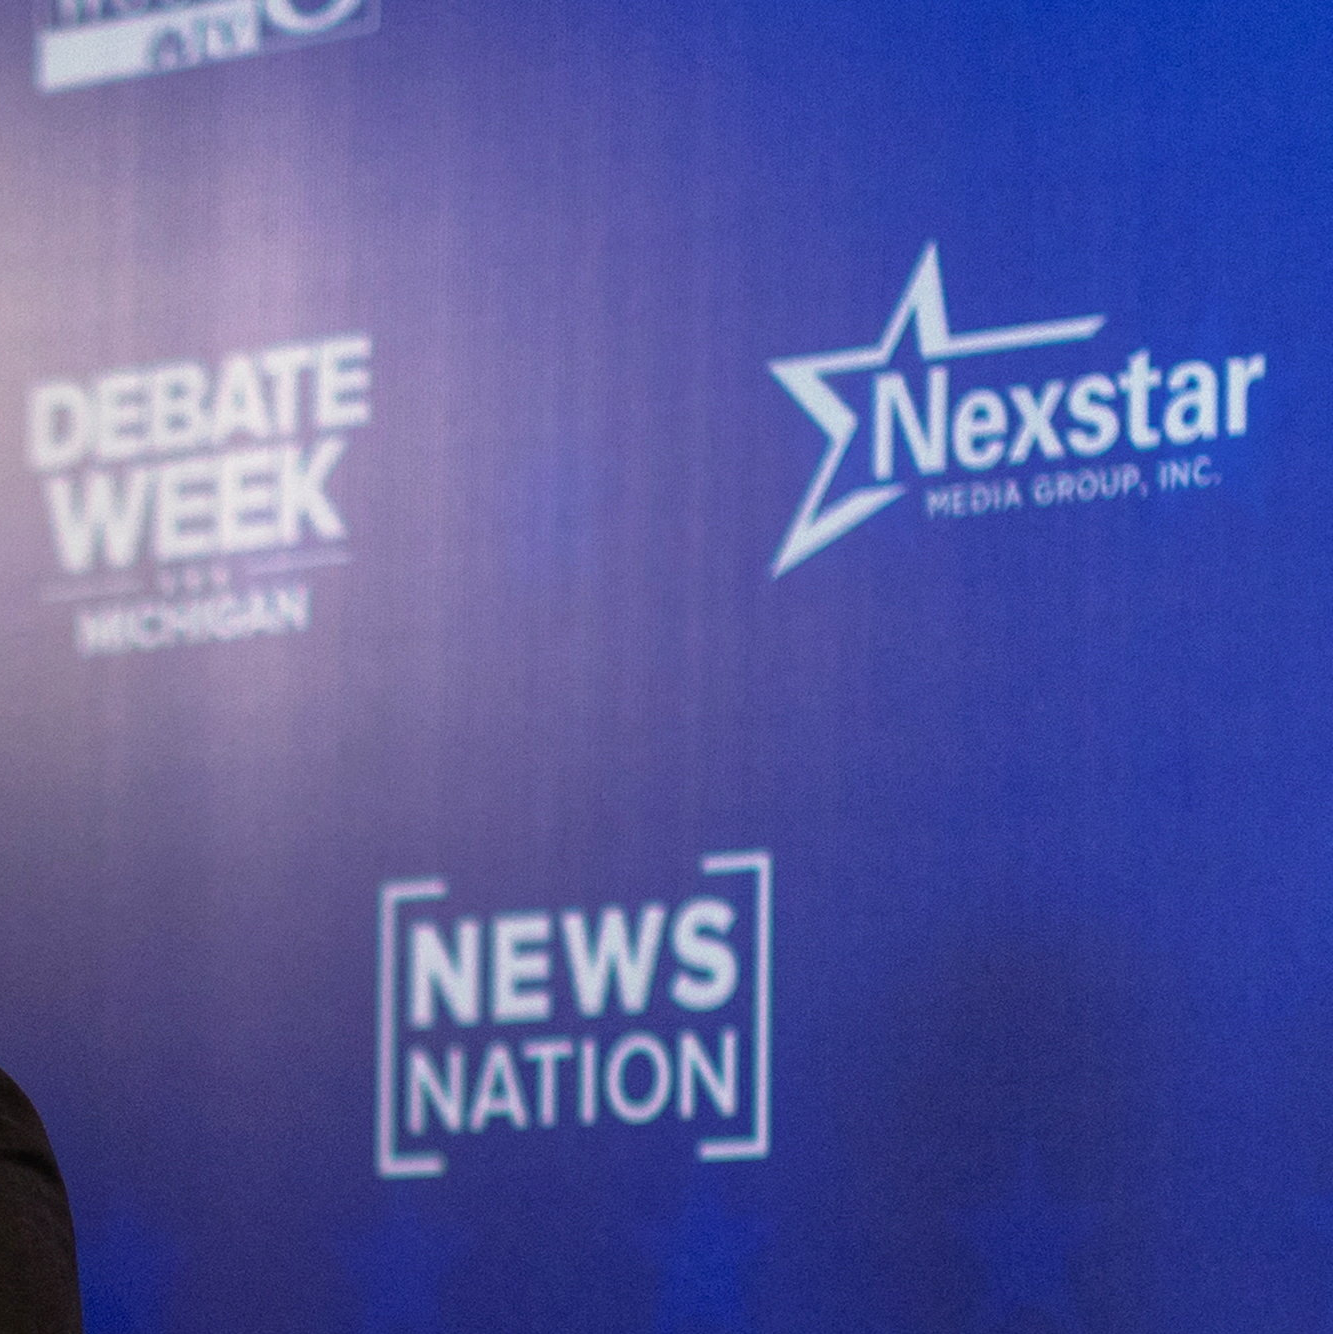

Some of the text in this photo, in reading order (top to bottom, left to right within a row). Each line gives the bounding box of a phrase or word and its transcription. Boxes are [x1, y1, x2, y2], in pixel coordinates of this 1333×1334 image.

[30, 335, 372, 472] DEBATE
[871, 348, 1266, 482] Nexstar
[46, 438, 345, 572] WEEK
[925, 454, 1222, 518] MEDIA GROUP, INC.
[410, 896, 739, 1030] NEWS
[407, 1030, 737, 1136] NATION
